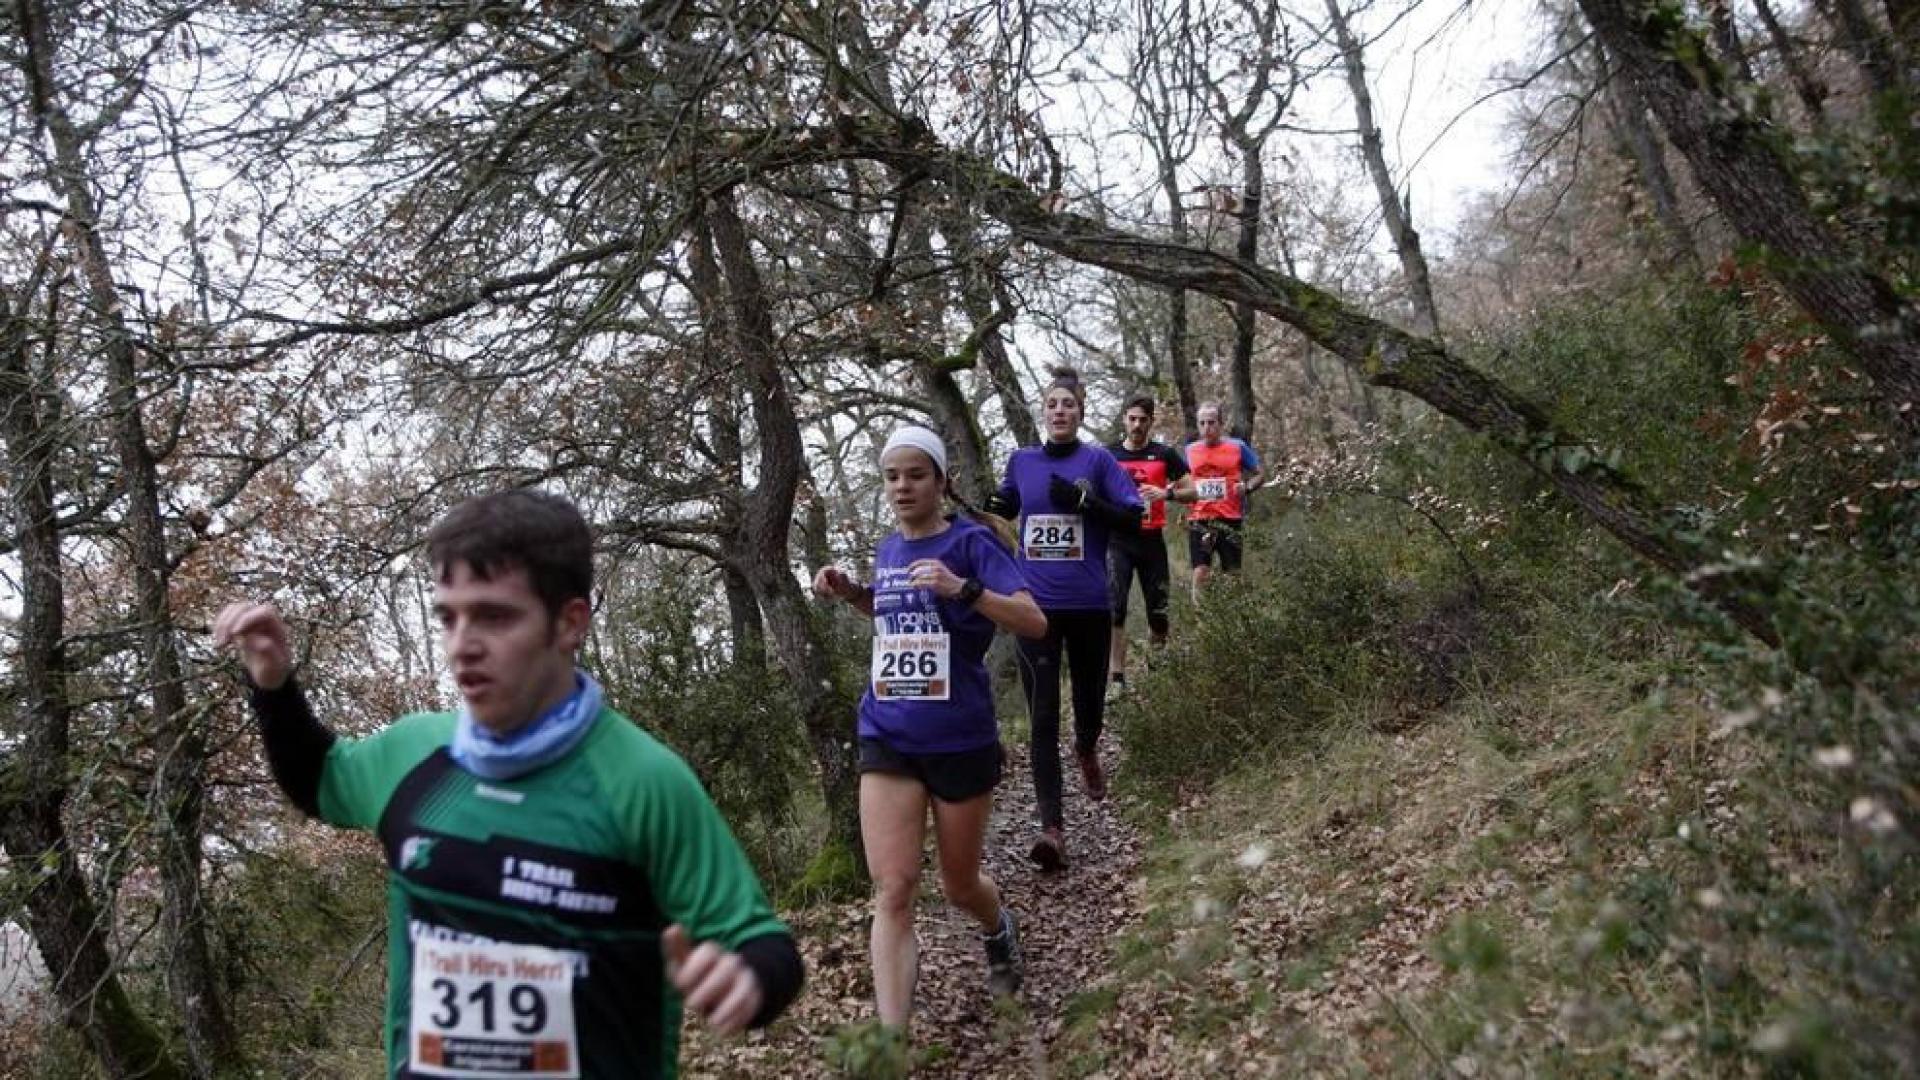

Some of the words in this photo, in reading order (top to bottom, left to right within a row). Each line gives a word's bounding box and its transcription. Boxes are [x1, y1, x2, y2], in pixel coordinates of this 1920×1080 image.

[1031, 526, 1075, 545] 284
[880, 651, 937, 677] 266
[431, 978, 548, 1035] 319
